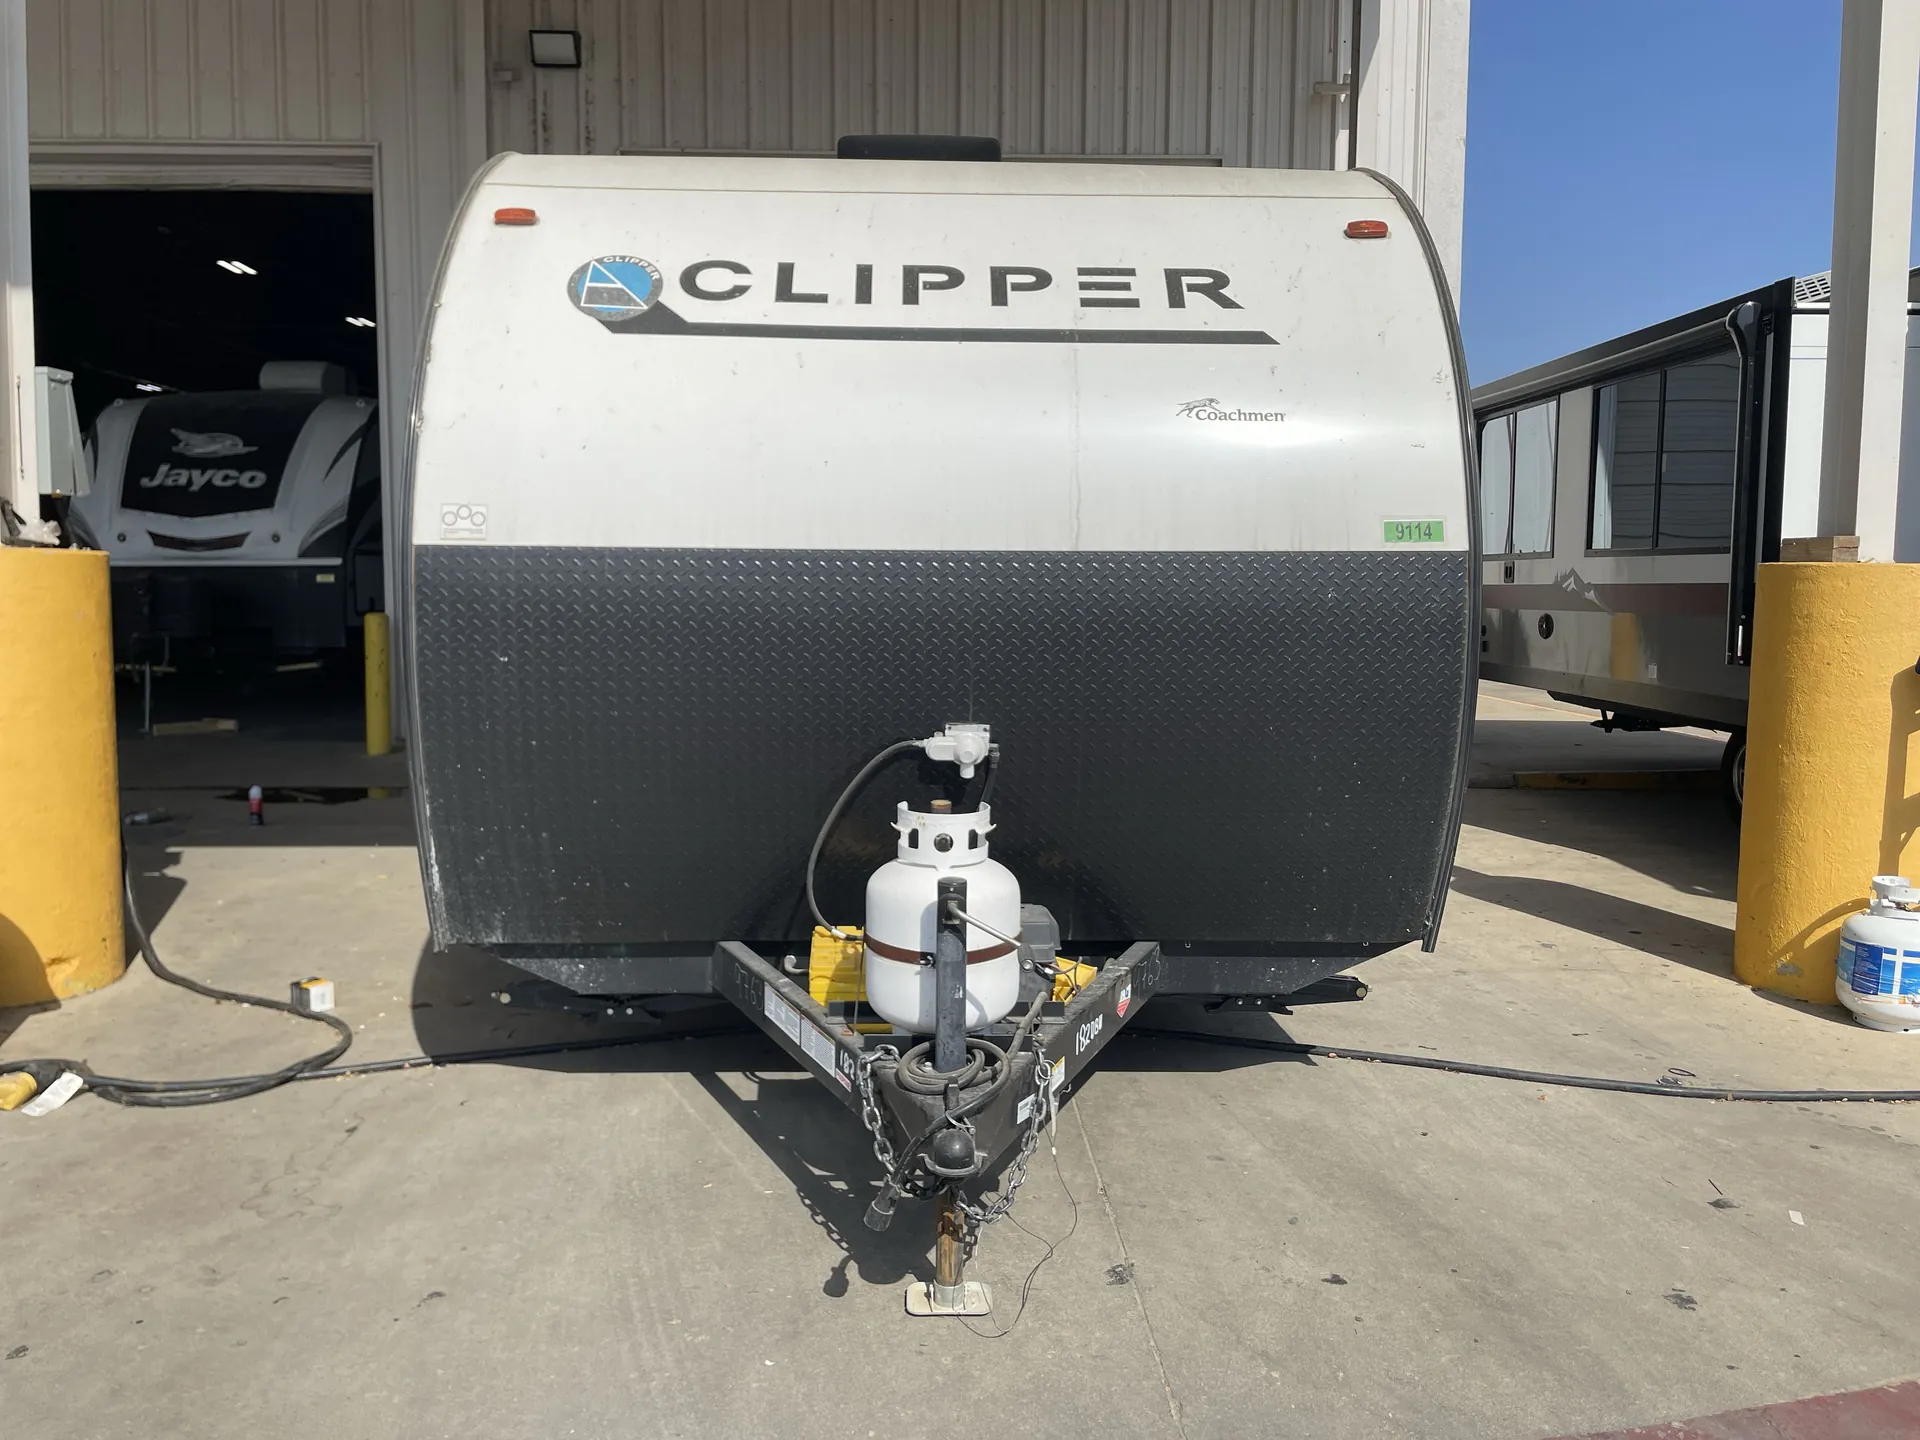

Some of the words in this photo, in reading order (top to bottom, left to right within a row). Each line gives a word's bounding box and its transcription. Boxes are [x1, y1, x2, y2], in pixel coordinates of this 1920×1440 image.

[603, 256, 661, 281] CLIPPER
[679, 259, 1246, 310] CLIPPER
[1195, 408, 1285, 422] Coachmen
[140, 462, 268, 492] Jayco
[1395, 521, 1433, 541] 9114
